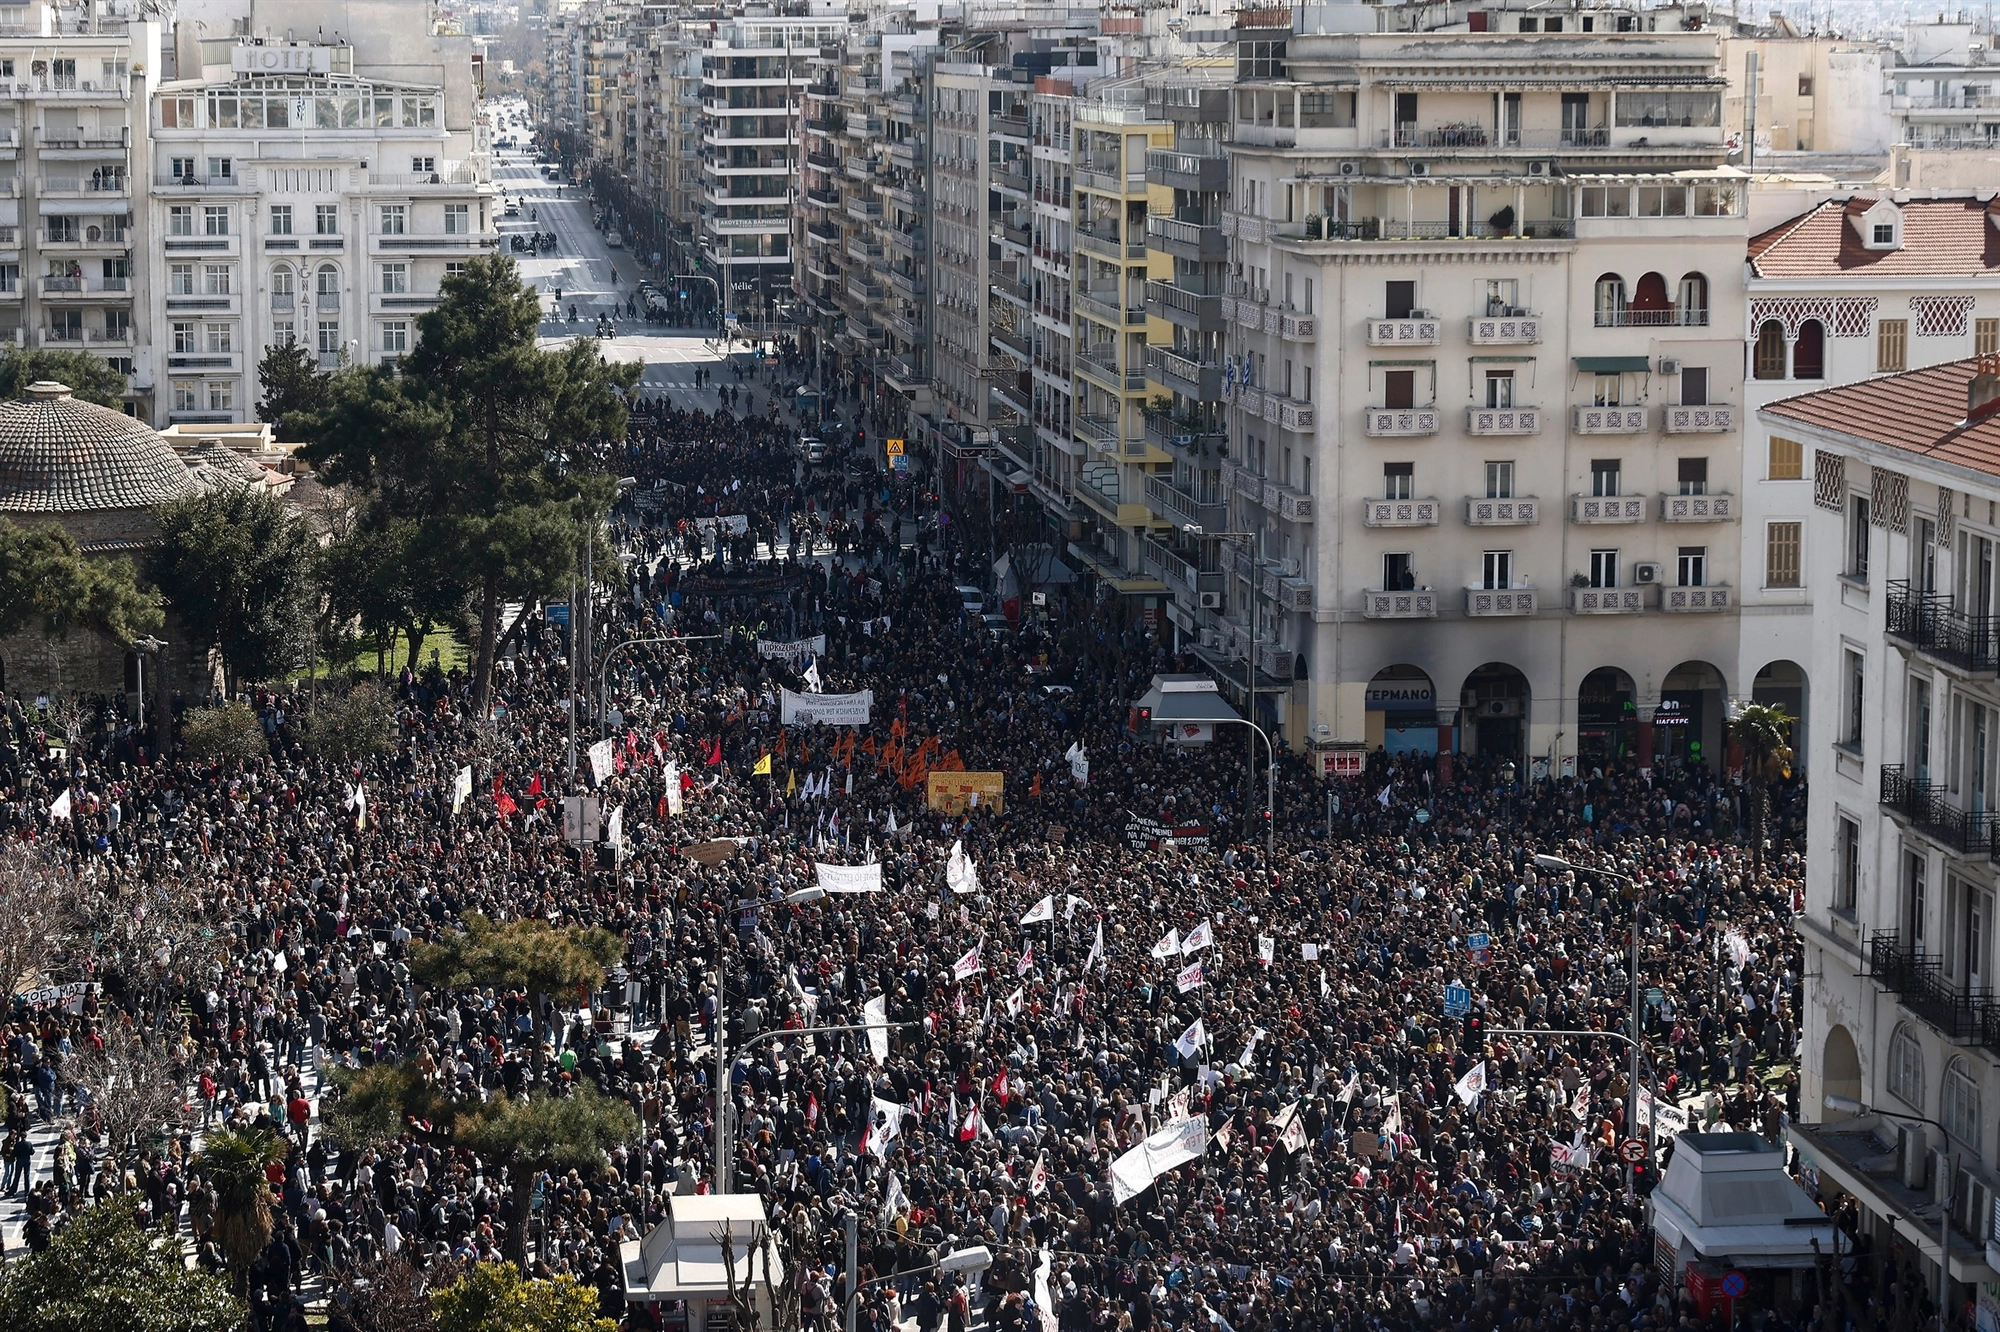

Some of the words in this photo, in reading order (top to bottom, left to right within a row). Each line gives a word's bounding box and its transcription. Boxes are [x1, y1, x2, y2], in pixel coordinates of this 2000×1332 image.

[246, 51, 317, 69] HOTEL
[298, 255, 312, 344] IGNATIA
[1365, 689, 1433, 701] ΓΕΡΜΑΝΟ
